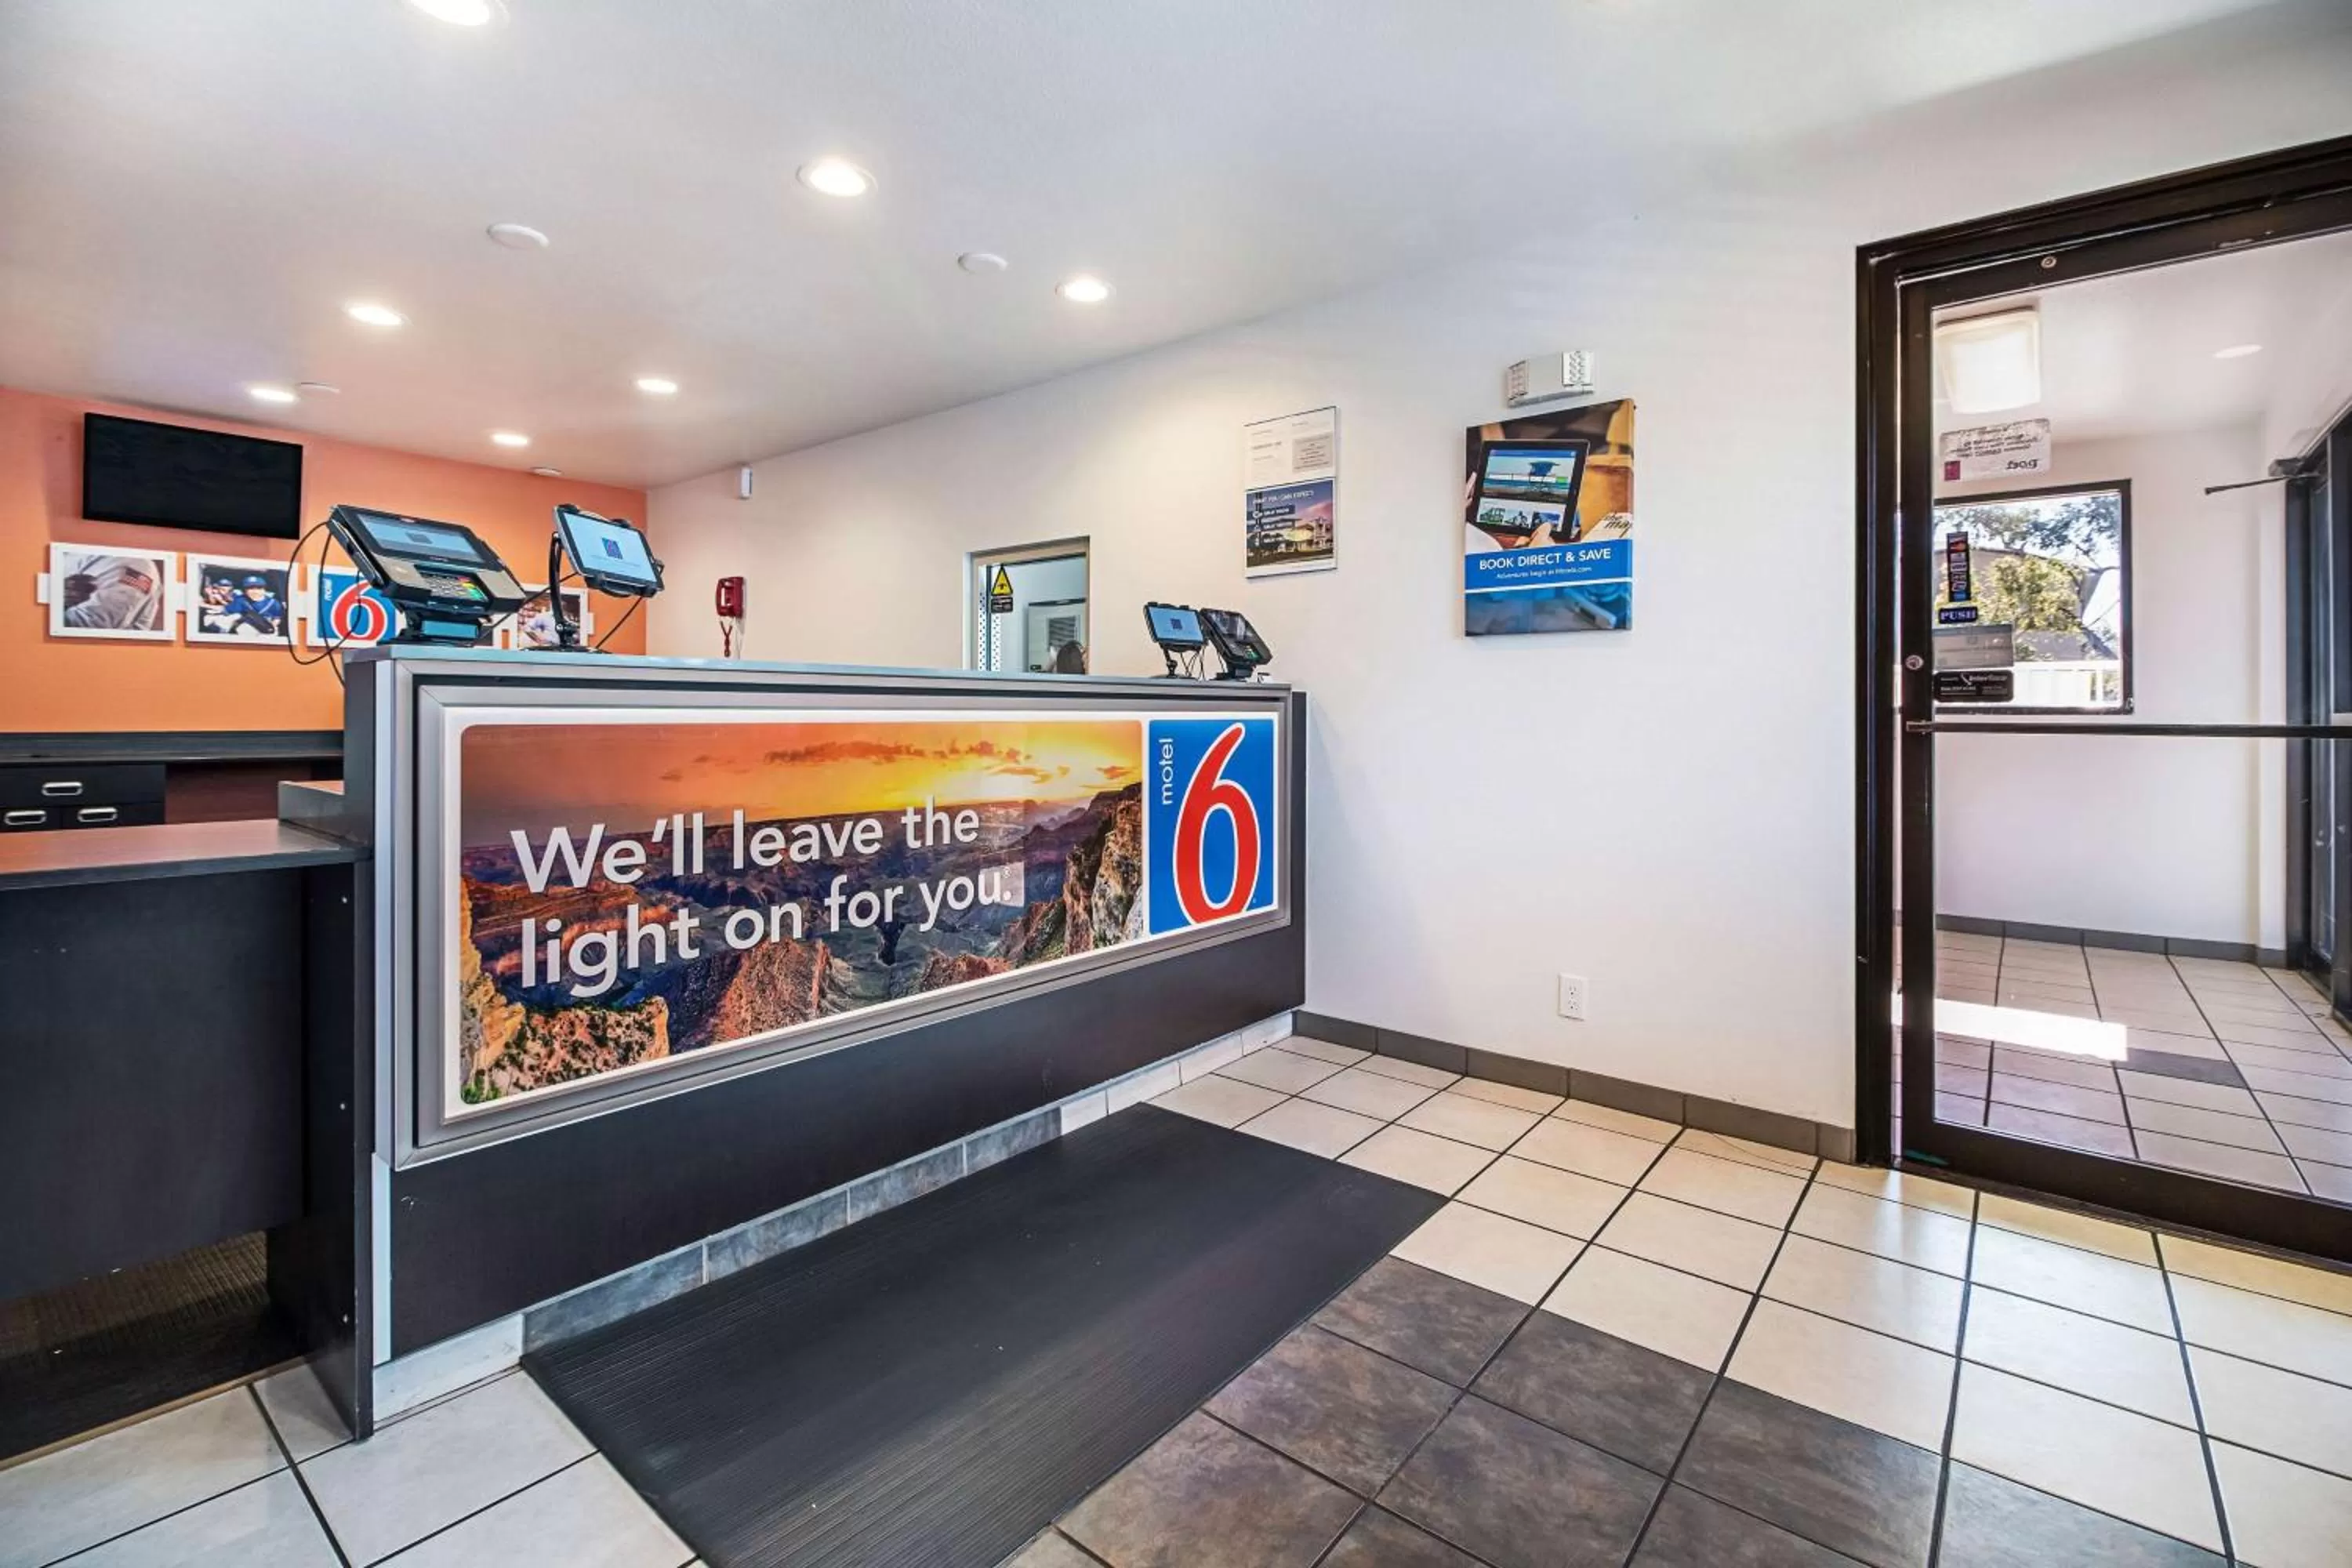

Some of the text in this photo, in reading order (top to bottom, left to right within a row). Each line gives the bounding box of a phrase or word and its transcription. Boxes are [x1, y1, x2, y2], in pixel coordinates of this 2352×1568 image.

[1479, 548, 1611, 570] BOOK DIRECT & SAVE
[330, 579, 388, 641] 6
[1940, 610, 1976, 620] PUSH
[1159, 737, 1174, 806] motel
[733, 808, 884, 871] leave
[900, 794, 979, 849] the
[1173, 722, 1261, 926] 6
[521, 903, 700, 998] light
[724, 901, 803, 950] on
[823, 875, 905, 932] for
